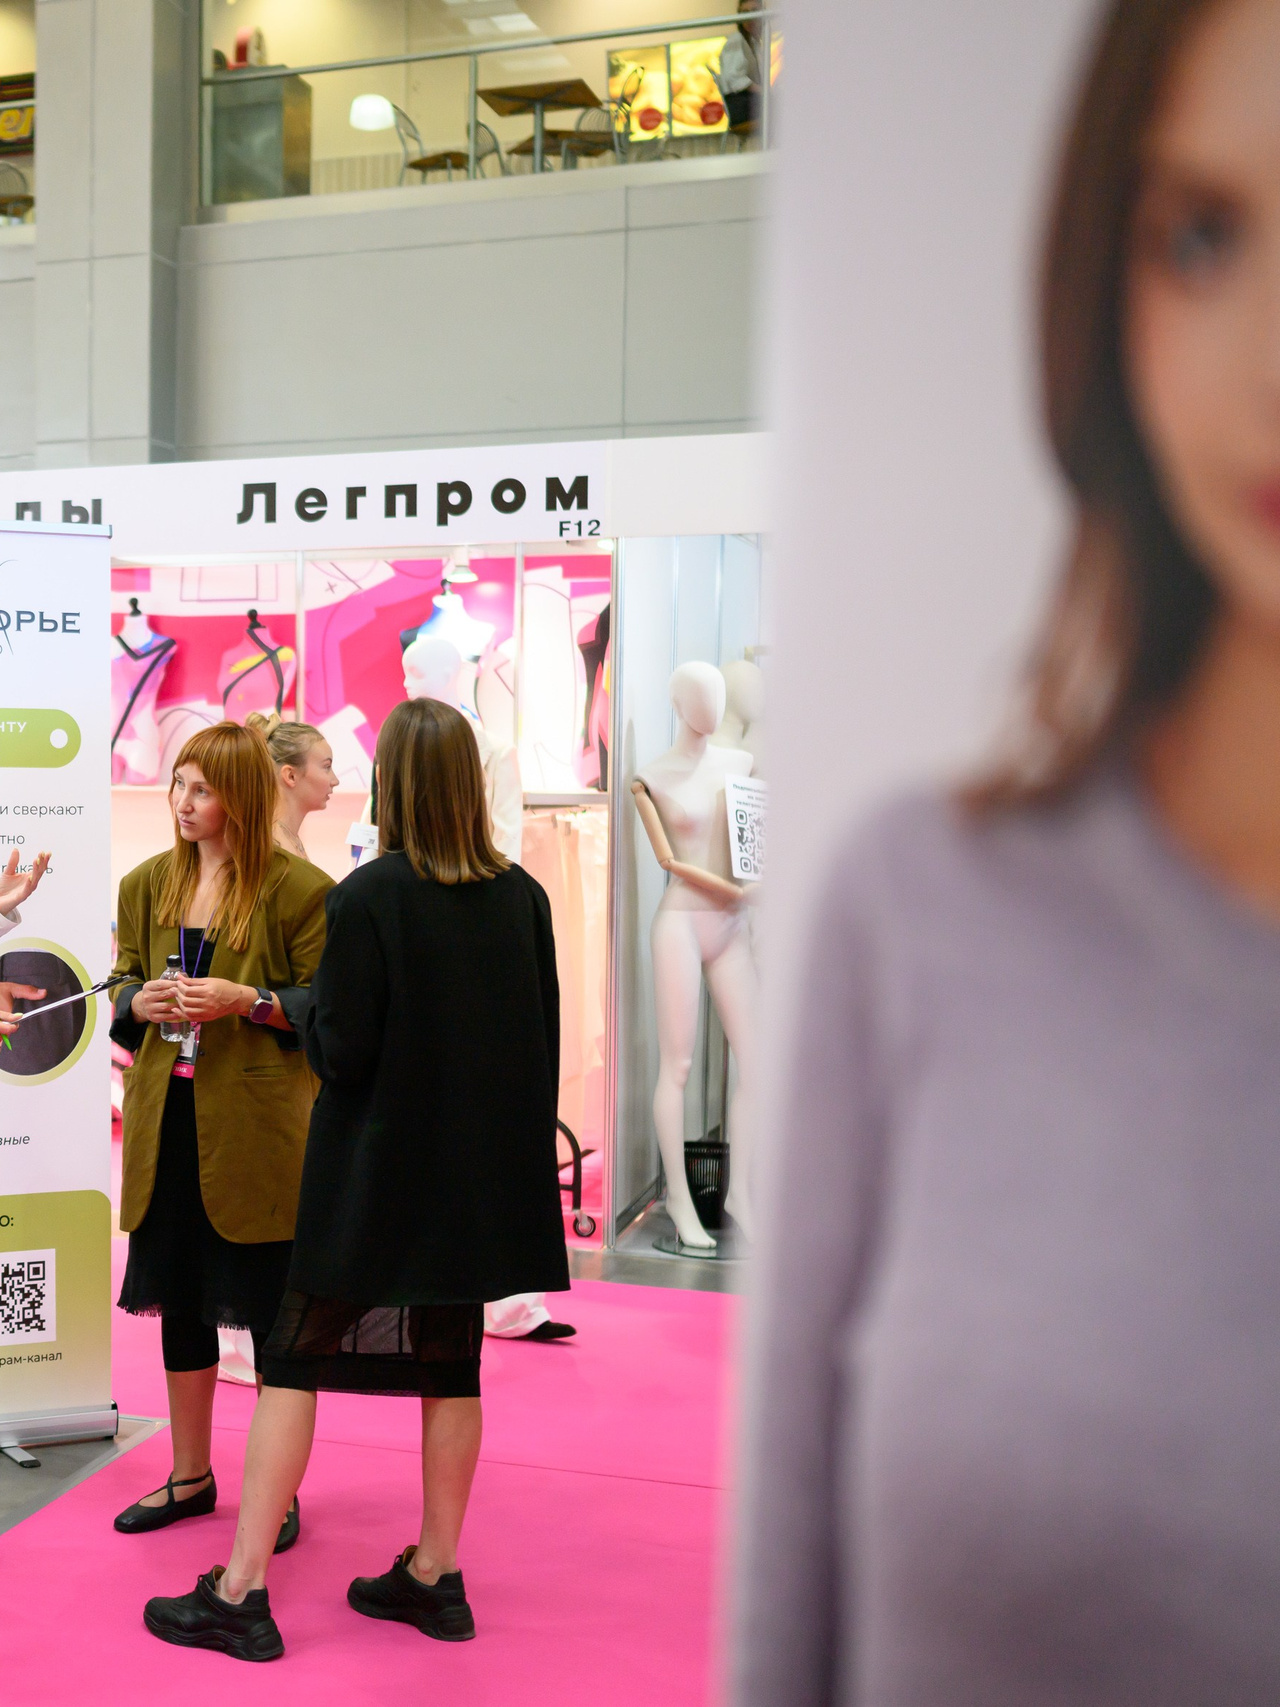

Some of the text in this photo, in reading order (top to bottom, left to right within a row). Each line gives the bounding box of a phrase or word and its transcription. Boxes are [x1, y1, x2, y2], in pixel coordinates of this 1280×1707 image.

[236, 476, 589, 526] Легпром
[559, 519, 601, 537] F12
[13, 804, 84, 818] сверкают
